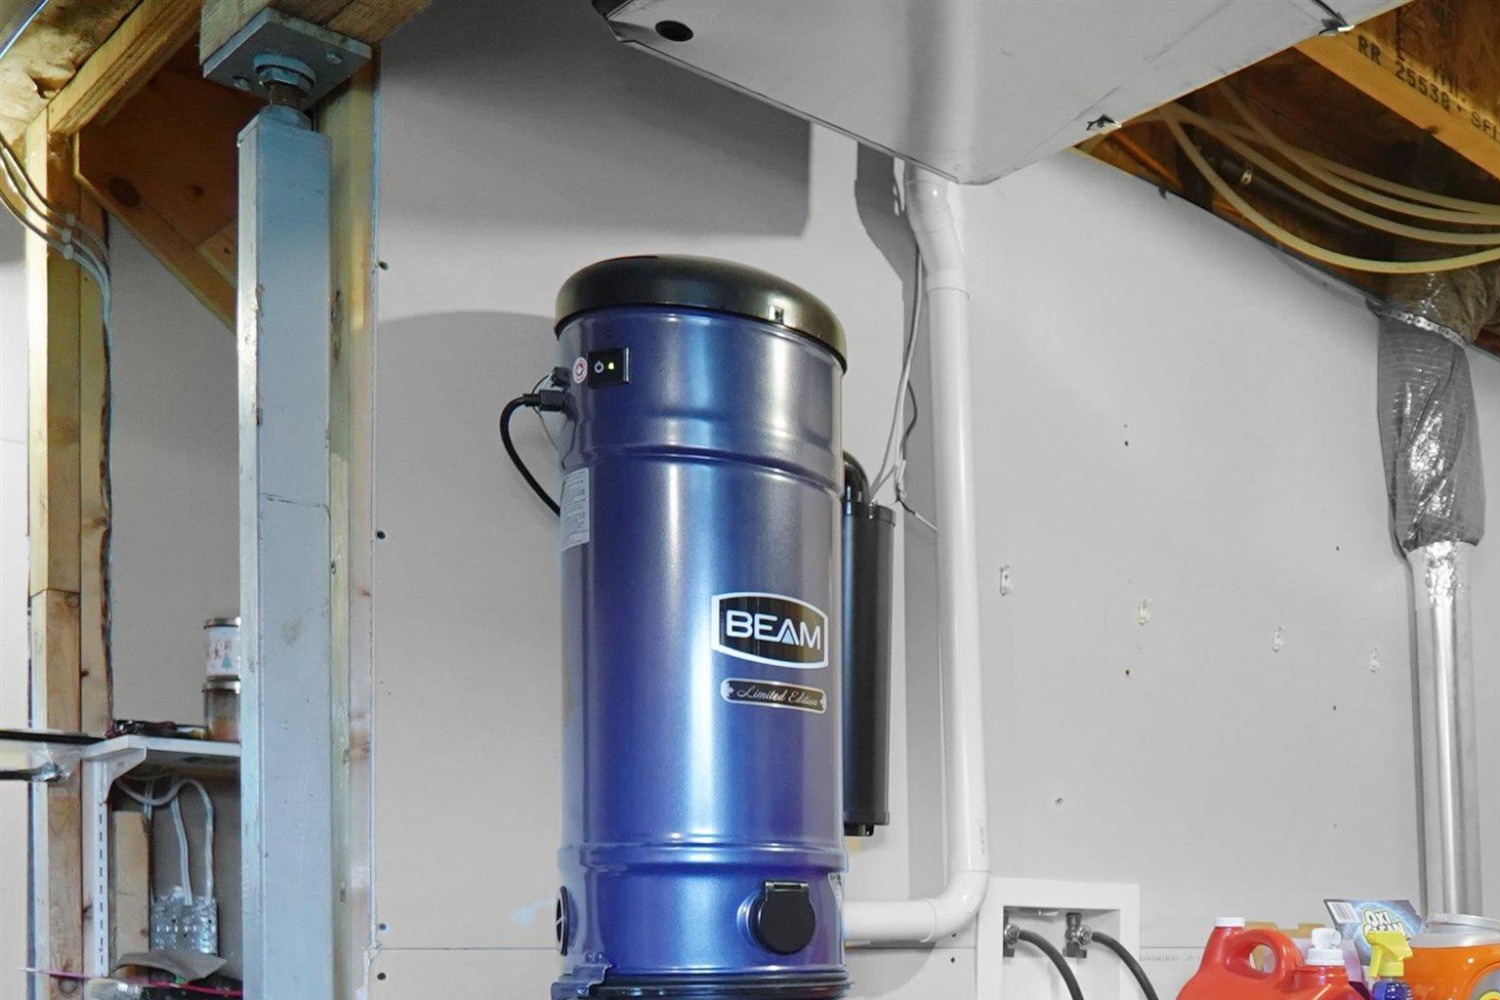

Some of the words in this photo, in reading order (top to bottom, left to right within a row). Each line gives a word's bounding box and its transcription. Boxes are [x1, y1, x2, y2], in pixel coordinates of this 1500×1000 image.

[1358, 34, 1381, 65] RR
[1395, 60, 1450, 112] 25538
[726, 609, 821, 651] BEAM
[736, 685, 785, 702] Limited
[788, 690, 819, 707] Edition
